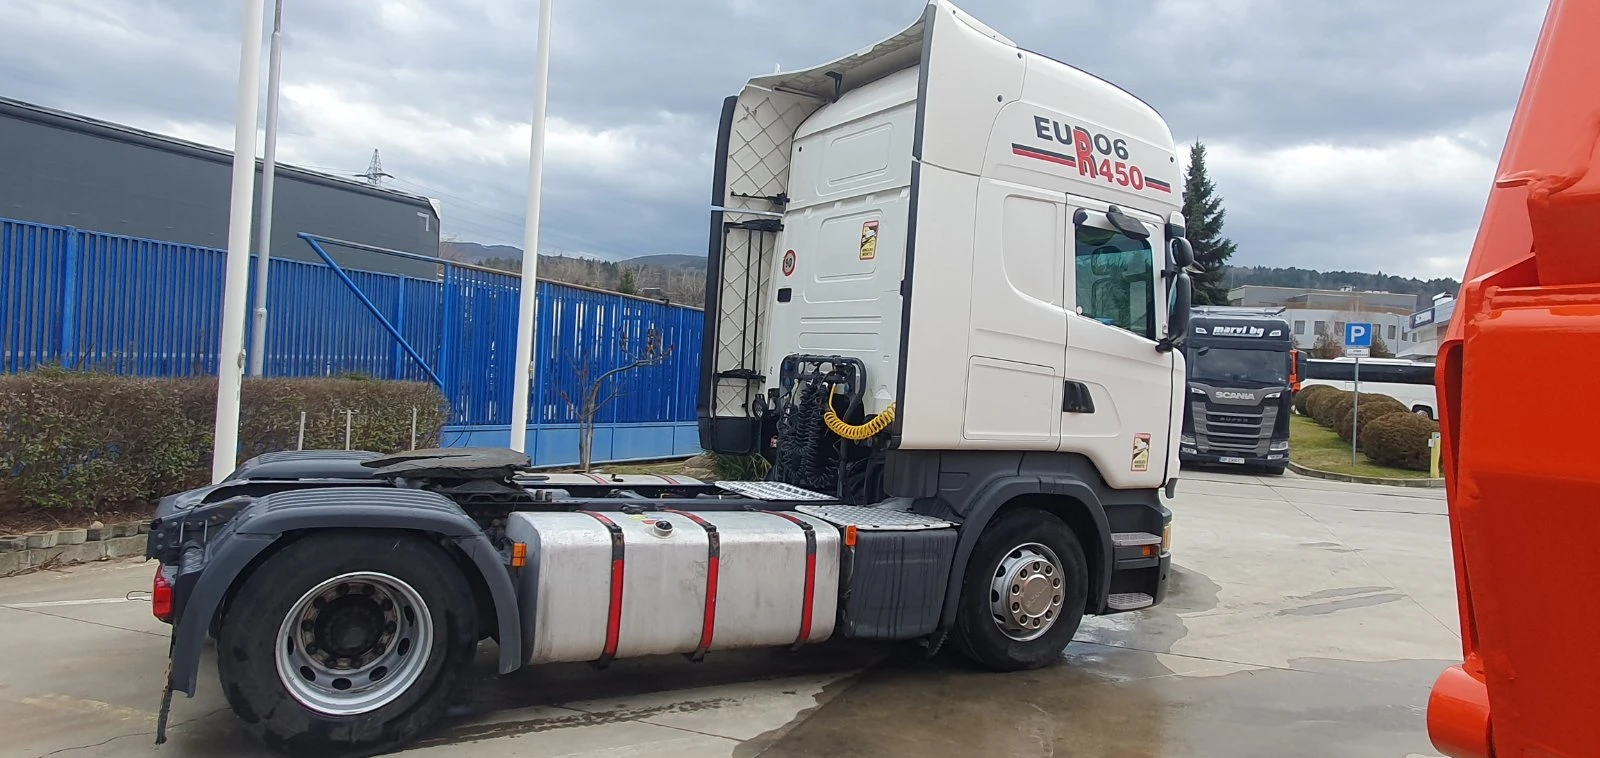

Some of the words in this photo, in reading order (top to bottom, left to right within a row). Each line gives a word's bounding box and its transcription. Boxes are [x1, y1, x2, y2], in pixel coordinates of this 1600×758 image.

[1073, 128, 1144, 191] R450
[1350, 325, 1365, 343] P
[1215, 391, 1255, 400] SCANIA
